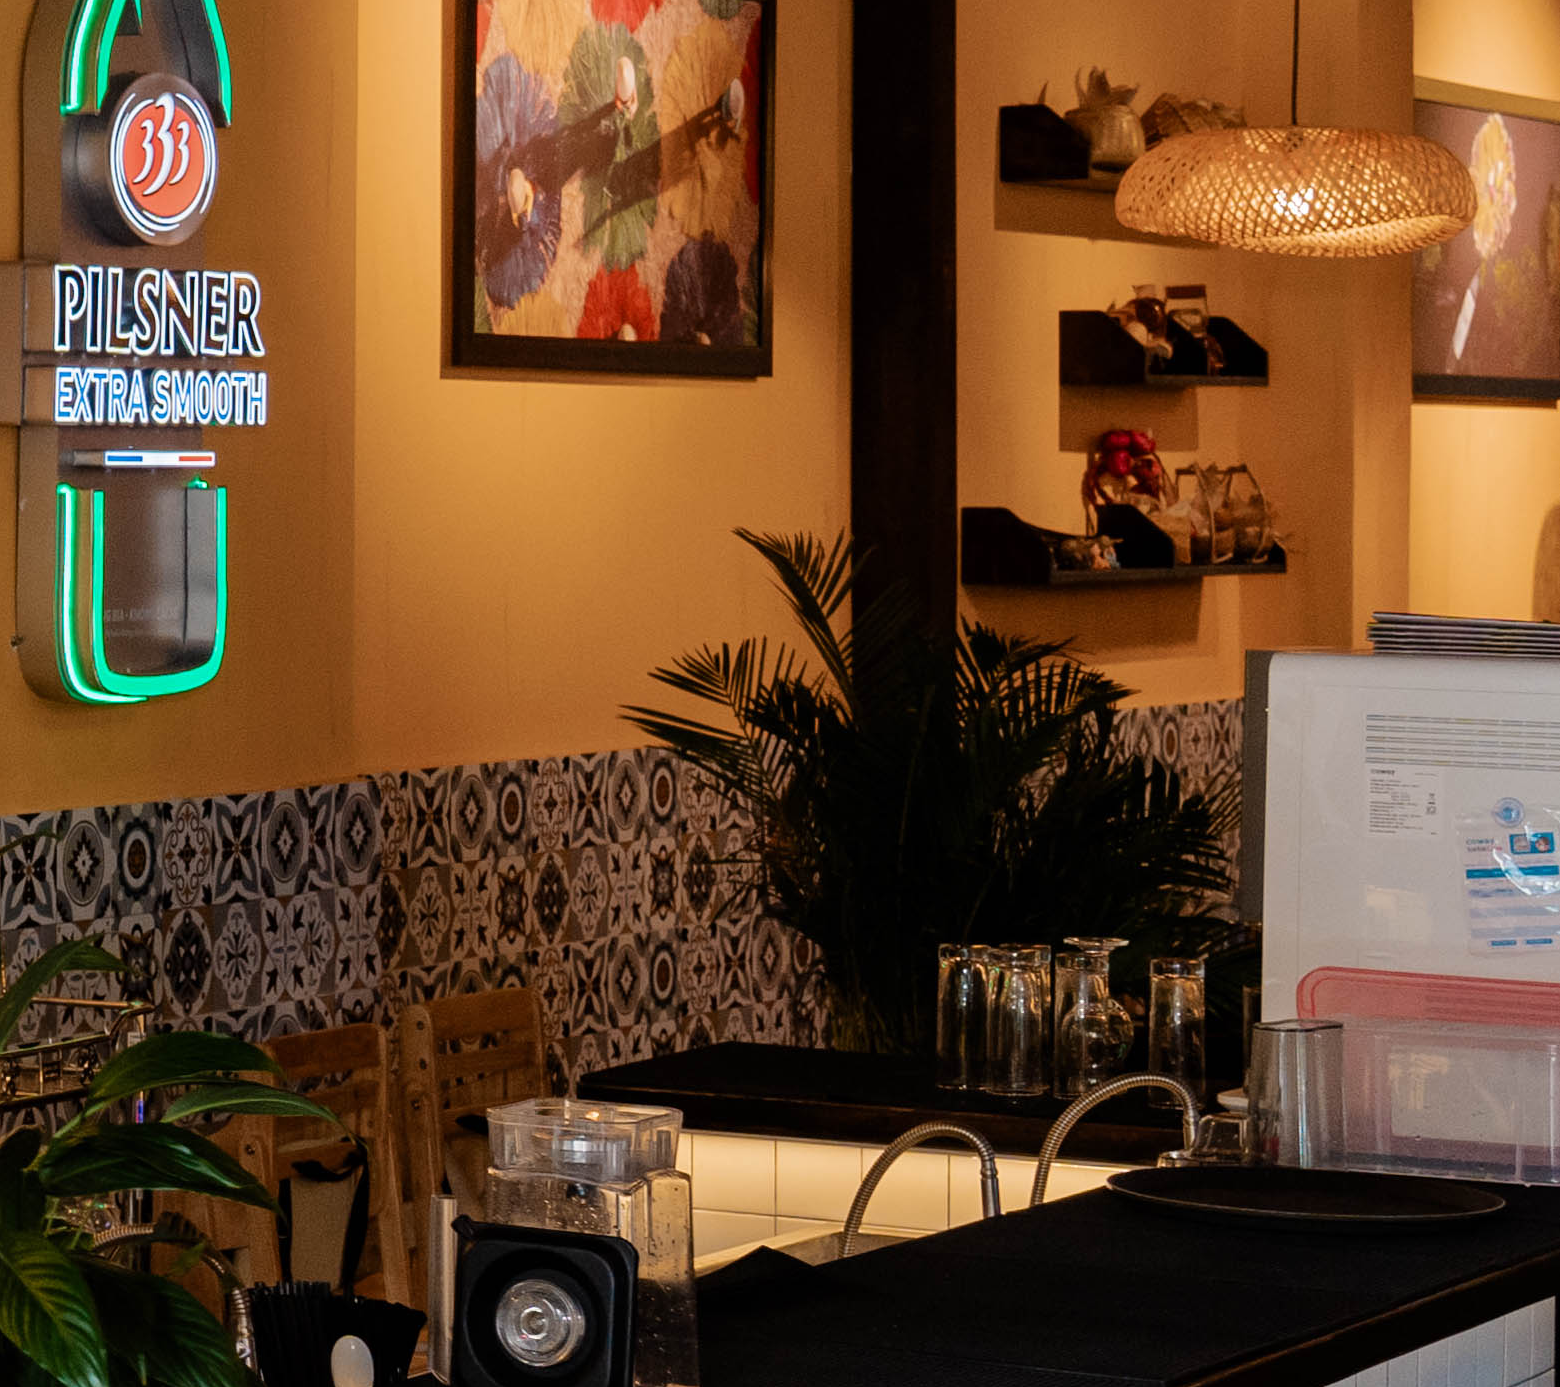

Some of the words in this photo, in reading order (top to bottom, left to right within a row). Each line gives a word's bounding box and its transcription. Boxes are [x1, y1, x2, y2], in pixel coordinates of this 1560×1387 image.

[132, 92, 190, 196] 333
[53, 263, 267, 358] PILSNER
[54, 366, 147, 424] EXTRA
[151, 368, 268, 427] SMOOTH
